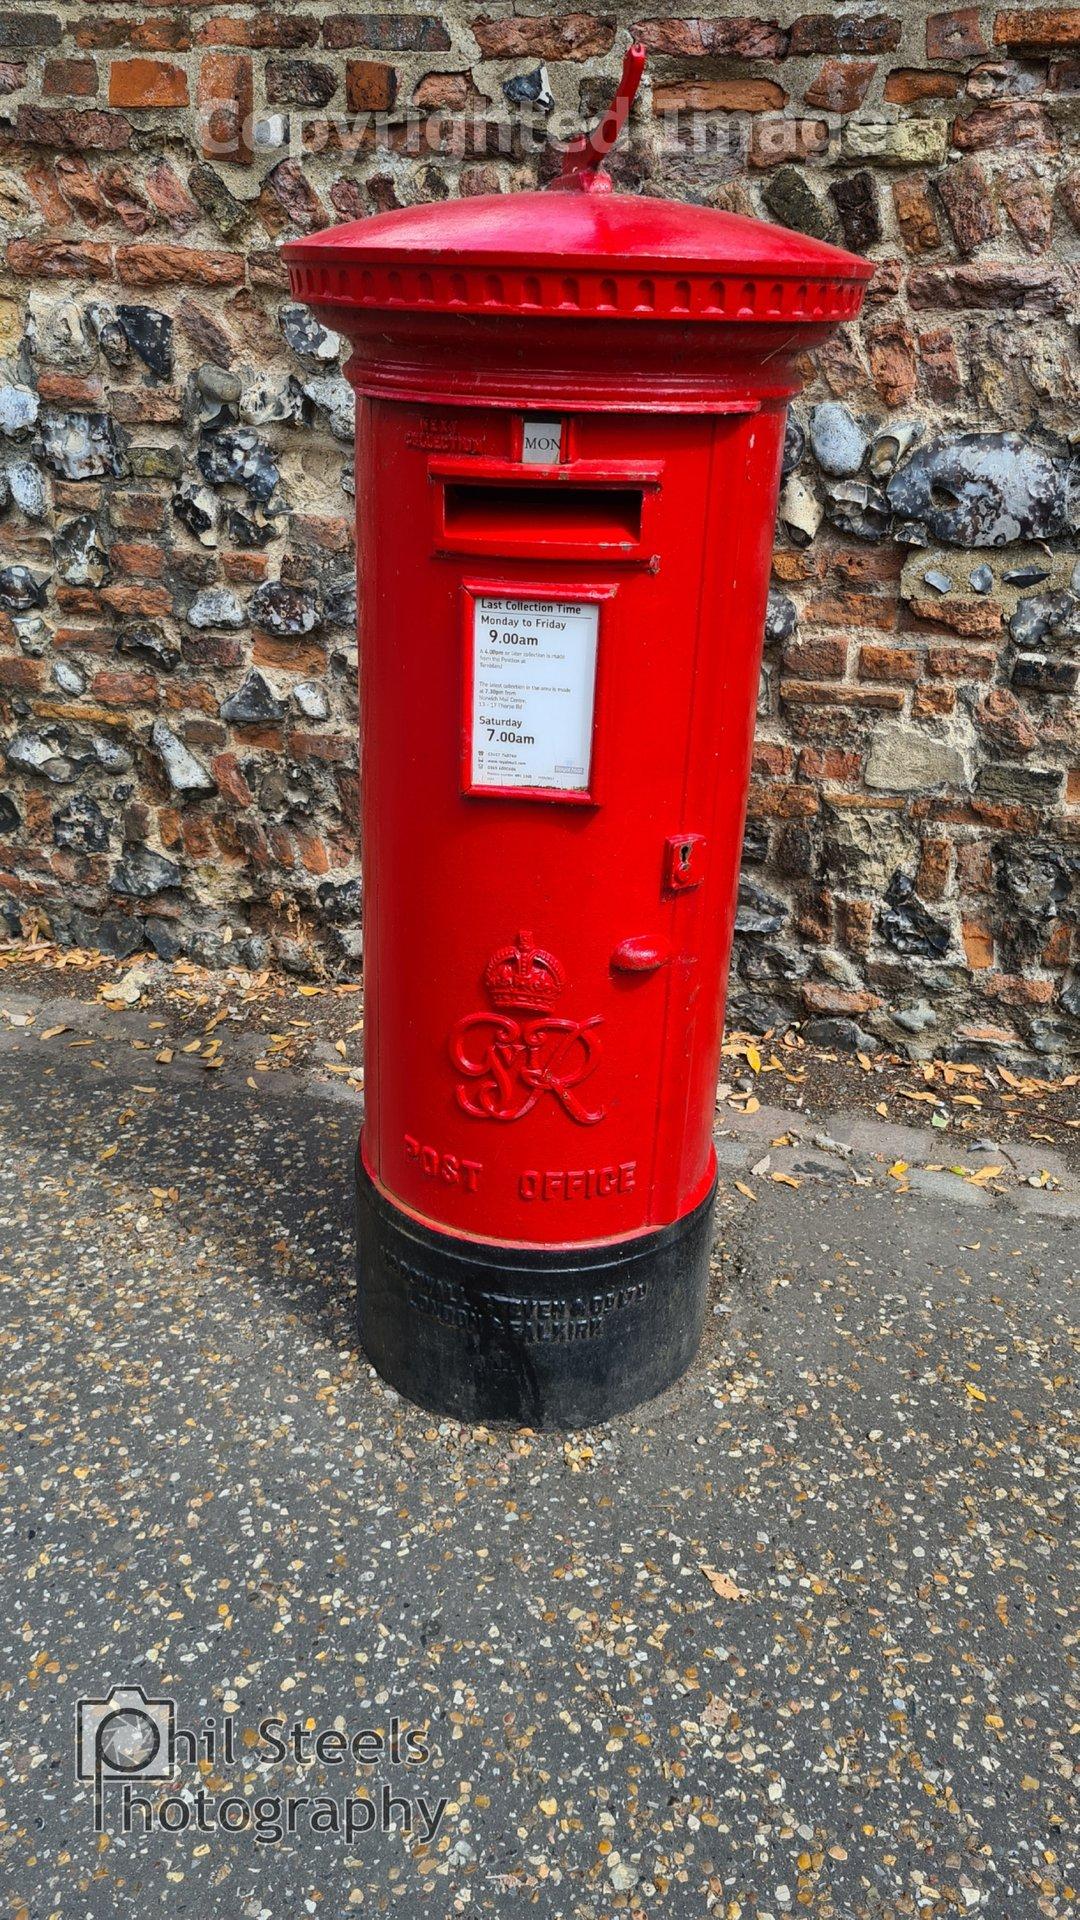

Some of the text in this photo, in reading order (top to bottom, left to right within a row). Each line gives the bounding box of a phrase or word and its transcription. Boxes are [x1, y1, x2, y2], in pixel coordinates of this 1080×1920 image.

[524, 437, 561, 451] MON
[481, 598, 582, 615] Last Collection Time
[481, 614, 567, 632] Monday to Friday
[488, 629, 539, 646] 9.00am
[479, 715, 523, 729] Saturday
[486, 728, 535, 745] 7.00am
[404, 1133, 637, 1201] POST OFFICE
